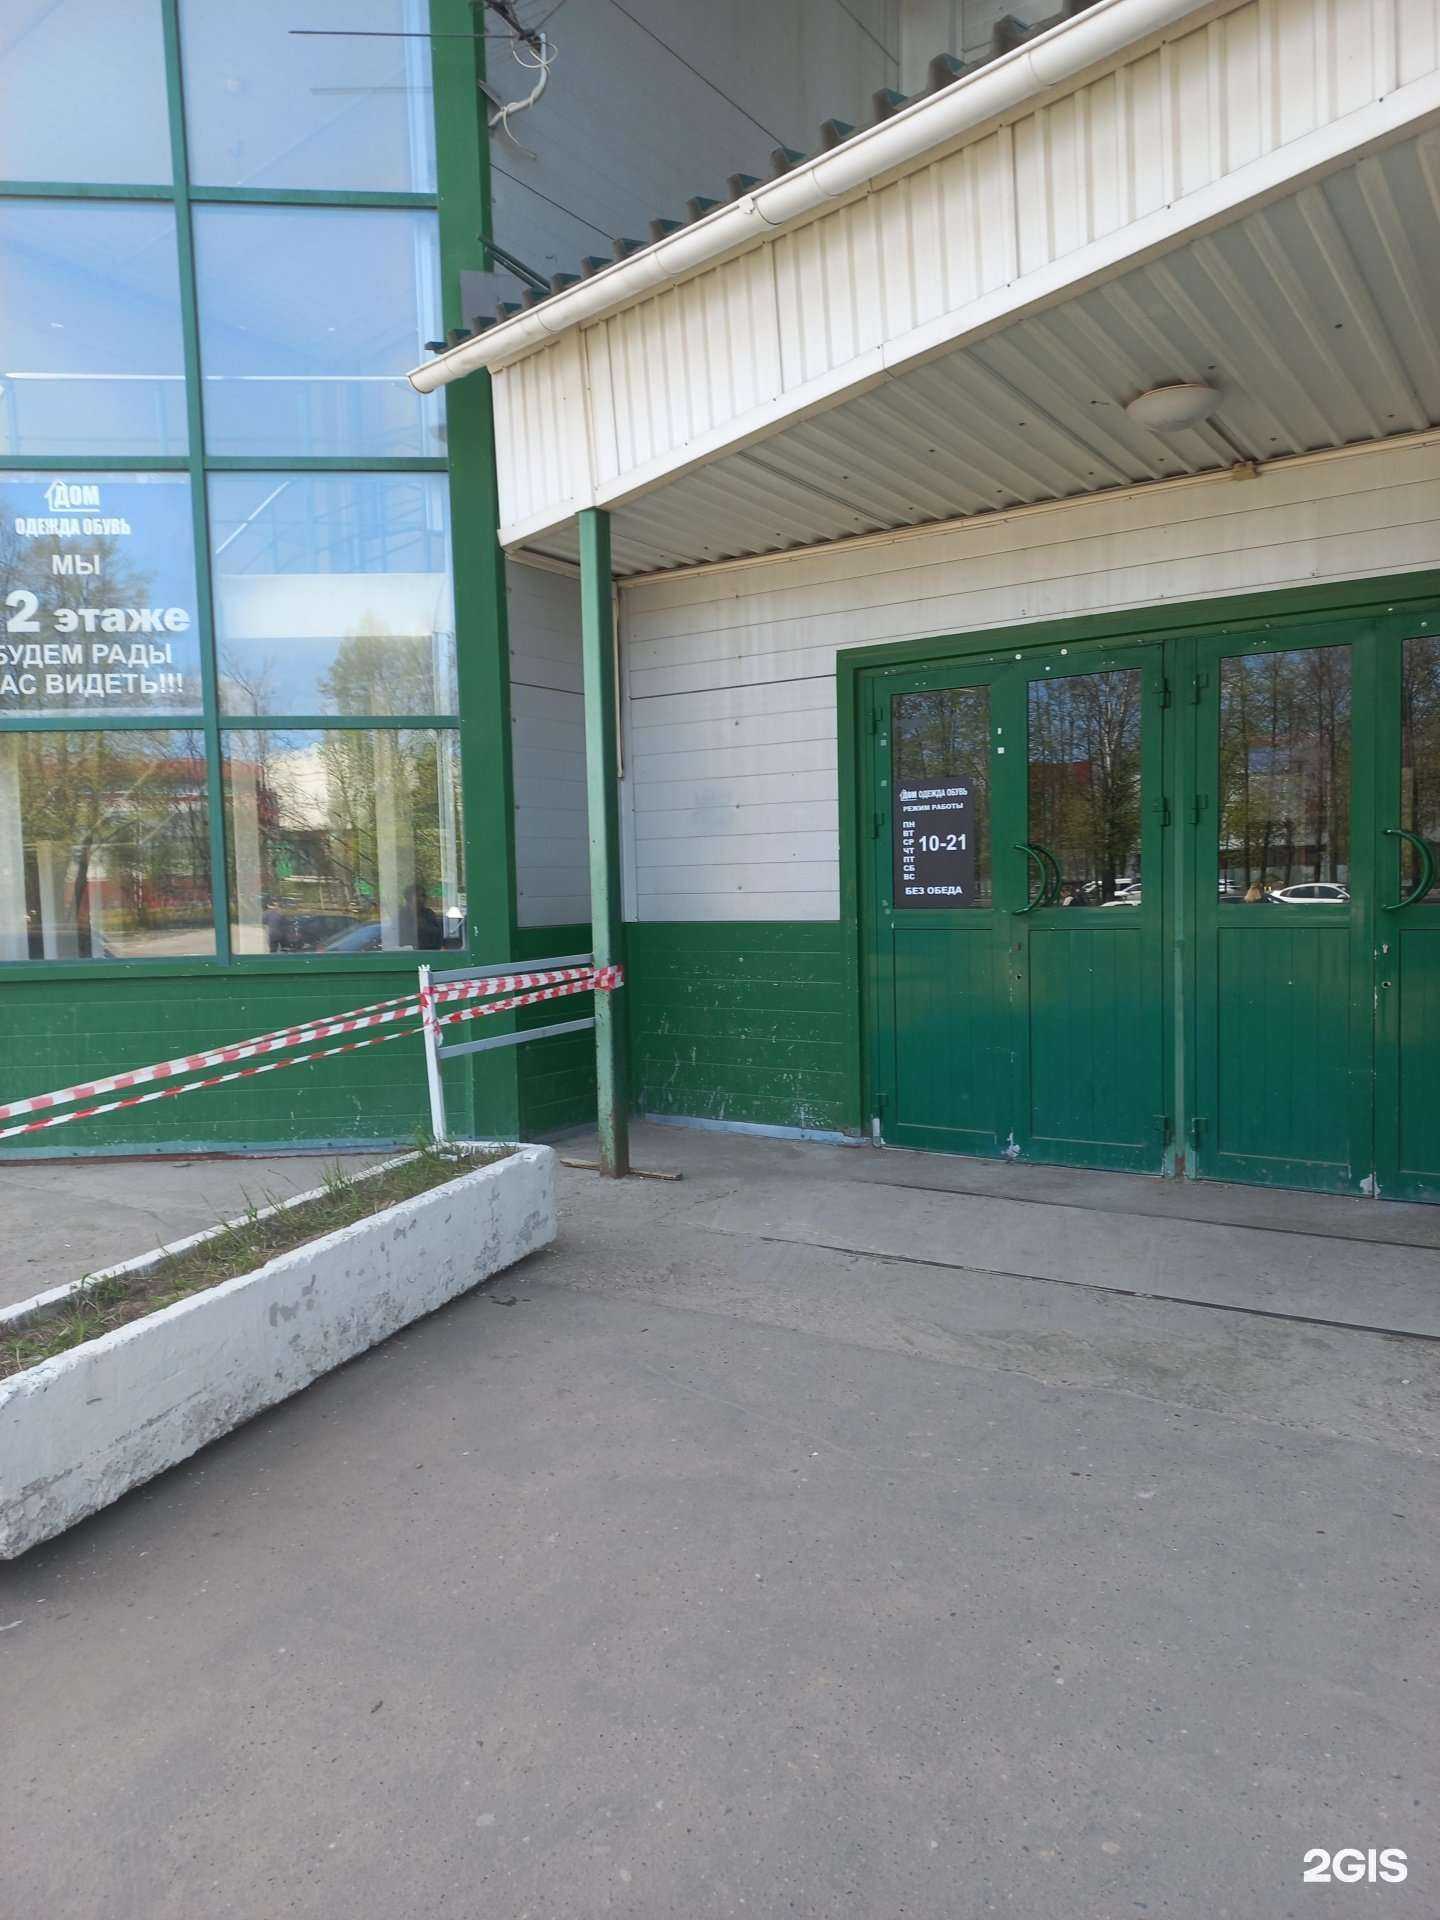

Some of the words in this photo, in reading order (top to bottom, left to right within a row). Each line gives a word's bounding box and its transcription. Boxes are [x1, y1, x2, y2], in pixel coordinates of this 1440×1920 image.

[54, 485, 100, 508] ДОМ
[15, 518, 81, 537] ОДЕЖДА
[83, 518, 131, 535] ОБУВЬ
[52, 554, 100, 575] МЫ
[5, 590, 40, 633] 2
[53, 607, 192, 633] этаже
[92, 643, 172, 668] РАДЫ
[45, 673, 183, 697] ВИДЕТЬ!!!
[918, 789, 945, 799] ОДЕЖДА
[946, 787, 968, 796] ОБУВЬ
[931, 802, 964, 810] РАБОТЫ
[903, 838, 915, 846] СР
[919, 833, 967, 851] 10-21
[905, 887, 925, 895] БЕЗ
[927, 886, 963, 895] ОБЕДА
